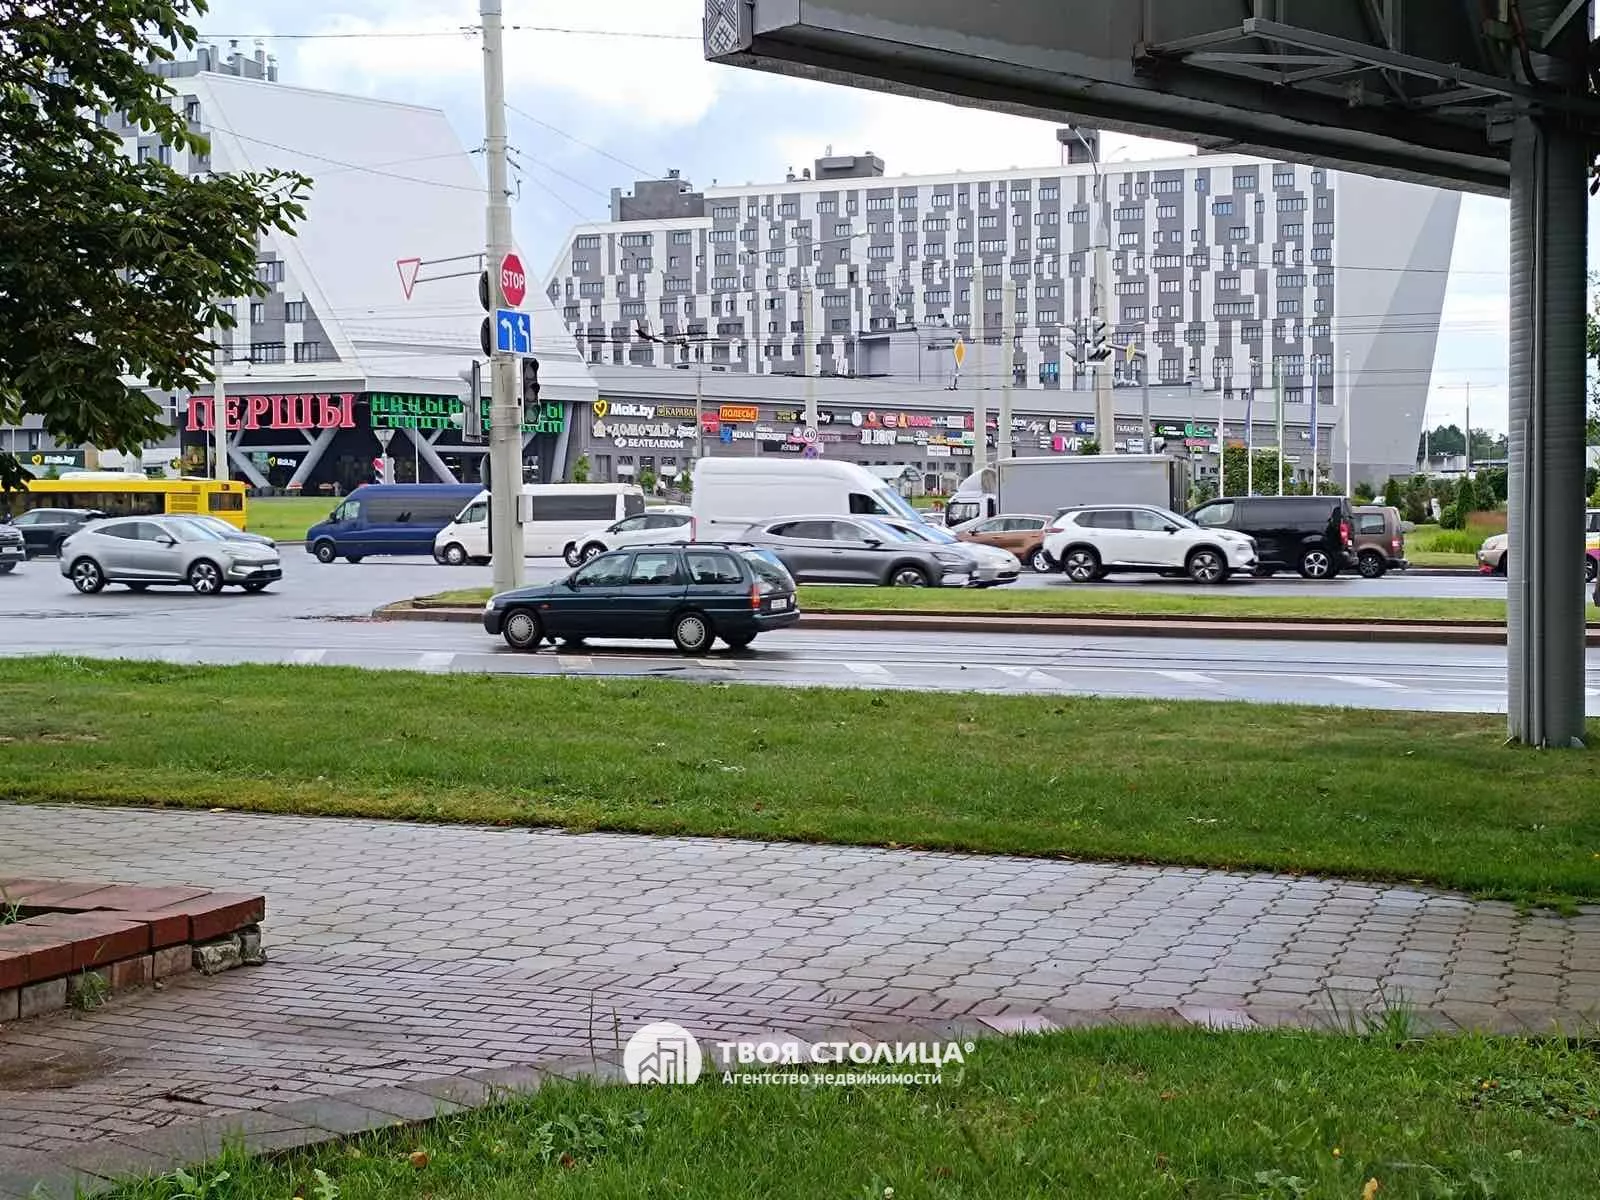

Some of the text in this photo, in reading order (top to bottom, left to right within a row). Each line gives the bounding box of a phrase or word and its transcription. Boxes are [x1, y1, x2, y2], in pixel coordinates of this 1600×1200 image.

[502, 269, 525, 291] STOP
[185, 393, 356, 432] ПЕРШЫ
[610, 403, 655, 419] Mak.by
[721, 408, 756, 419] ПОЛЕСЬЕ
[804, 430, 816, 438] 40
[628, 439, 684, 449] БЕЛТЕЛЕКОМ
